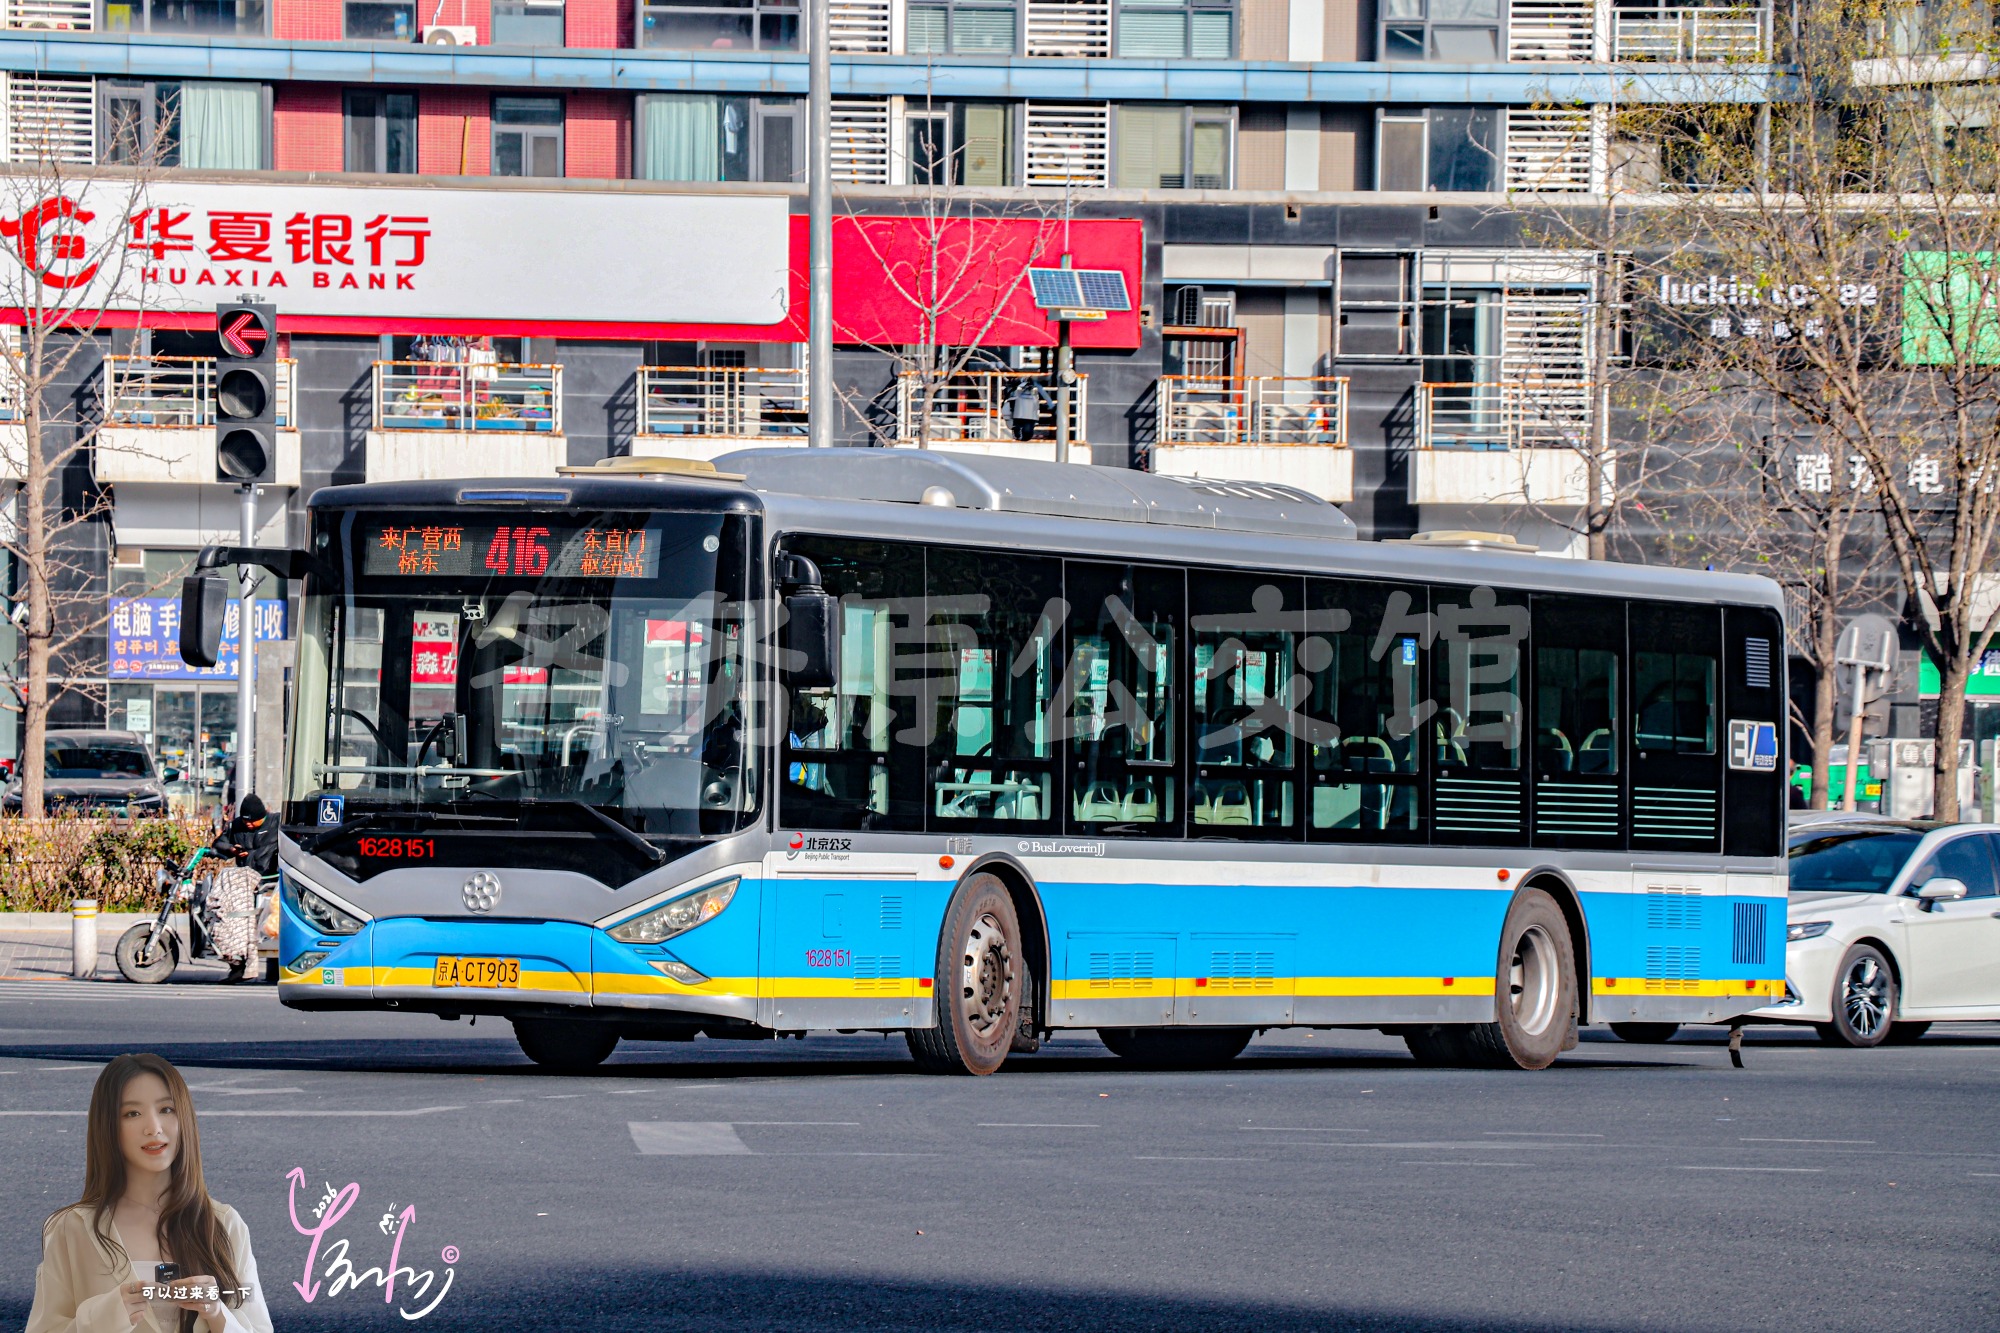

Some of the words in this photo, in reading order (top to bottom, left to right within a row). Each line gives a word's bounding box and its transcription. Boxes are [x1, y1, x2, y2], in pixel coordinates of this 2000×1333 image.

[127, 208, 432, 267] 华夏银行
[141, 266, 288, 288] HUAXIA
[313, 272, 416, 290] BANK
[379, 526, 464, 551] 来广营西
[485, 526, 551, 575] 416
[583, 528, 646, 553] 东直门
[398, 549, 439, 575] 桥东
[579, 552, 644, 577] 枢纽站
[357, 837, 434, 858] 1628151
[807, 837, 852, 850] 北京公交
[804, 852, 818, 862] Beijing
[818, 852, 830, 861] Public
[830, 853, 850, 861] Transport
[805, 949, 851, 967] 1628151
